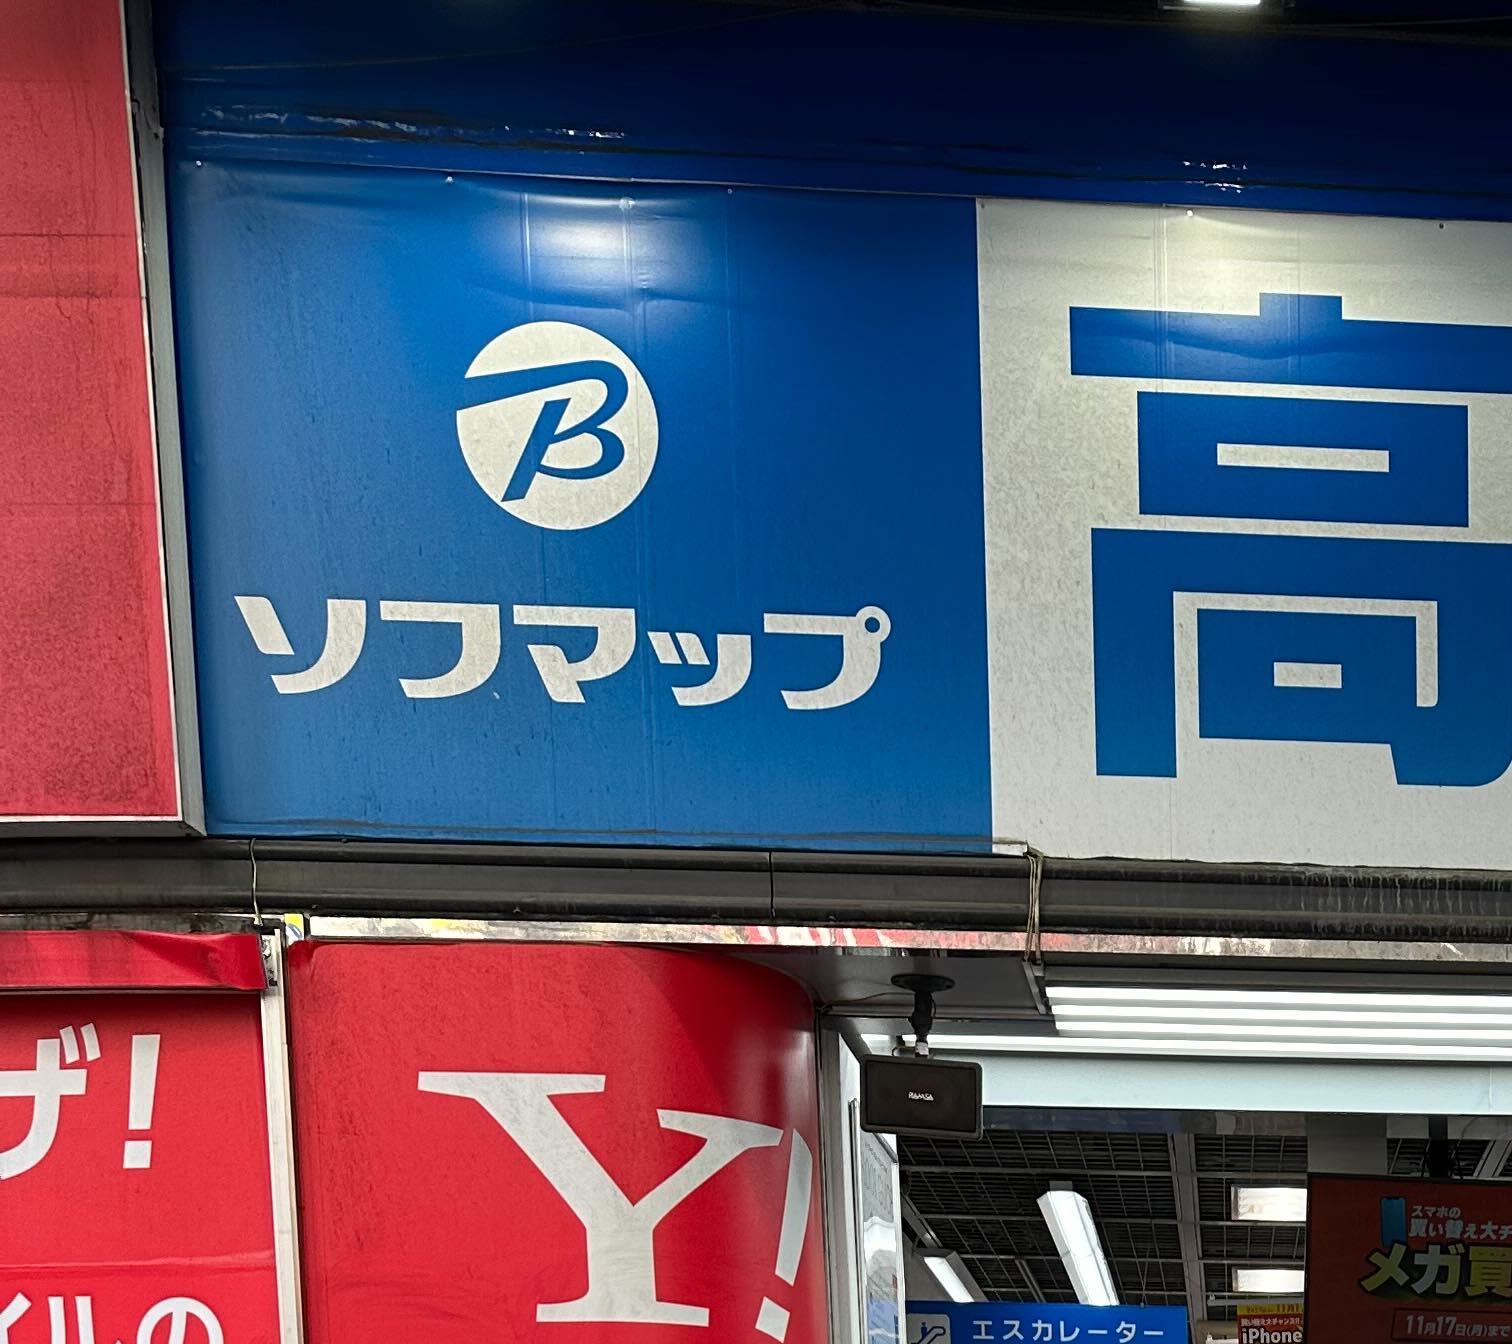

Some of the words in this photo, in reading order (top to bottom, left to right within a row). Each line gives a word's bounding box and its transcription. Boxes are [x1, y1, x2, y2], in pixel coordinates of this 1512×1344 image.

[234, 594, 891, 711] ソフマップ
[418, 1071, 813, 1344] Y!
[972, 1318, 1164, 1344] エスカレーター
[1242, 1326, 1303, 1344] iPhone
